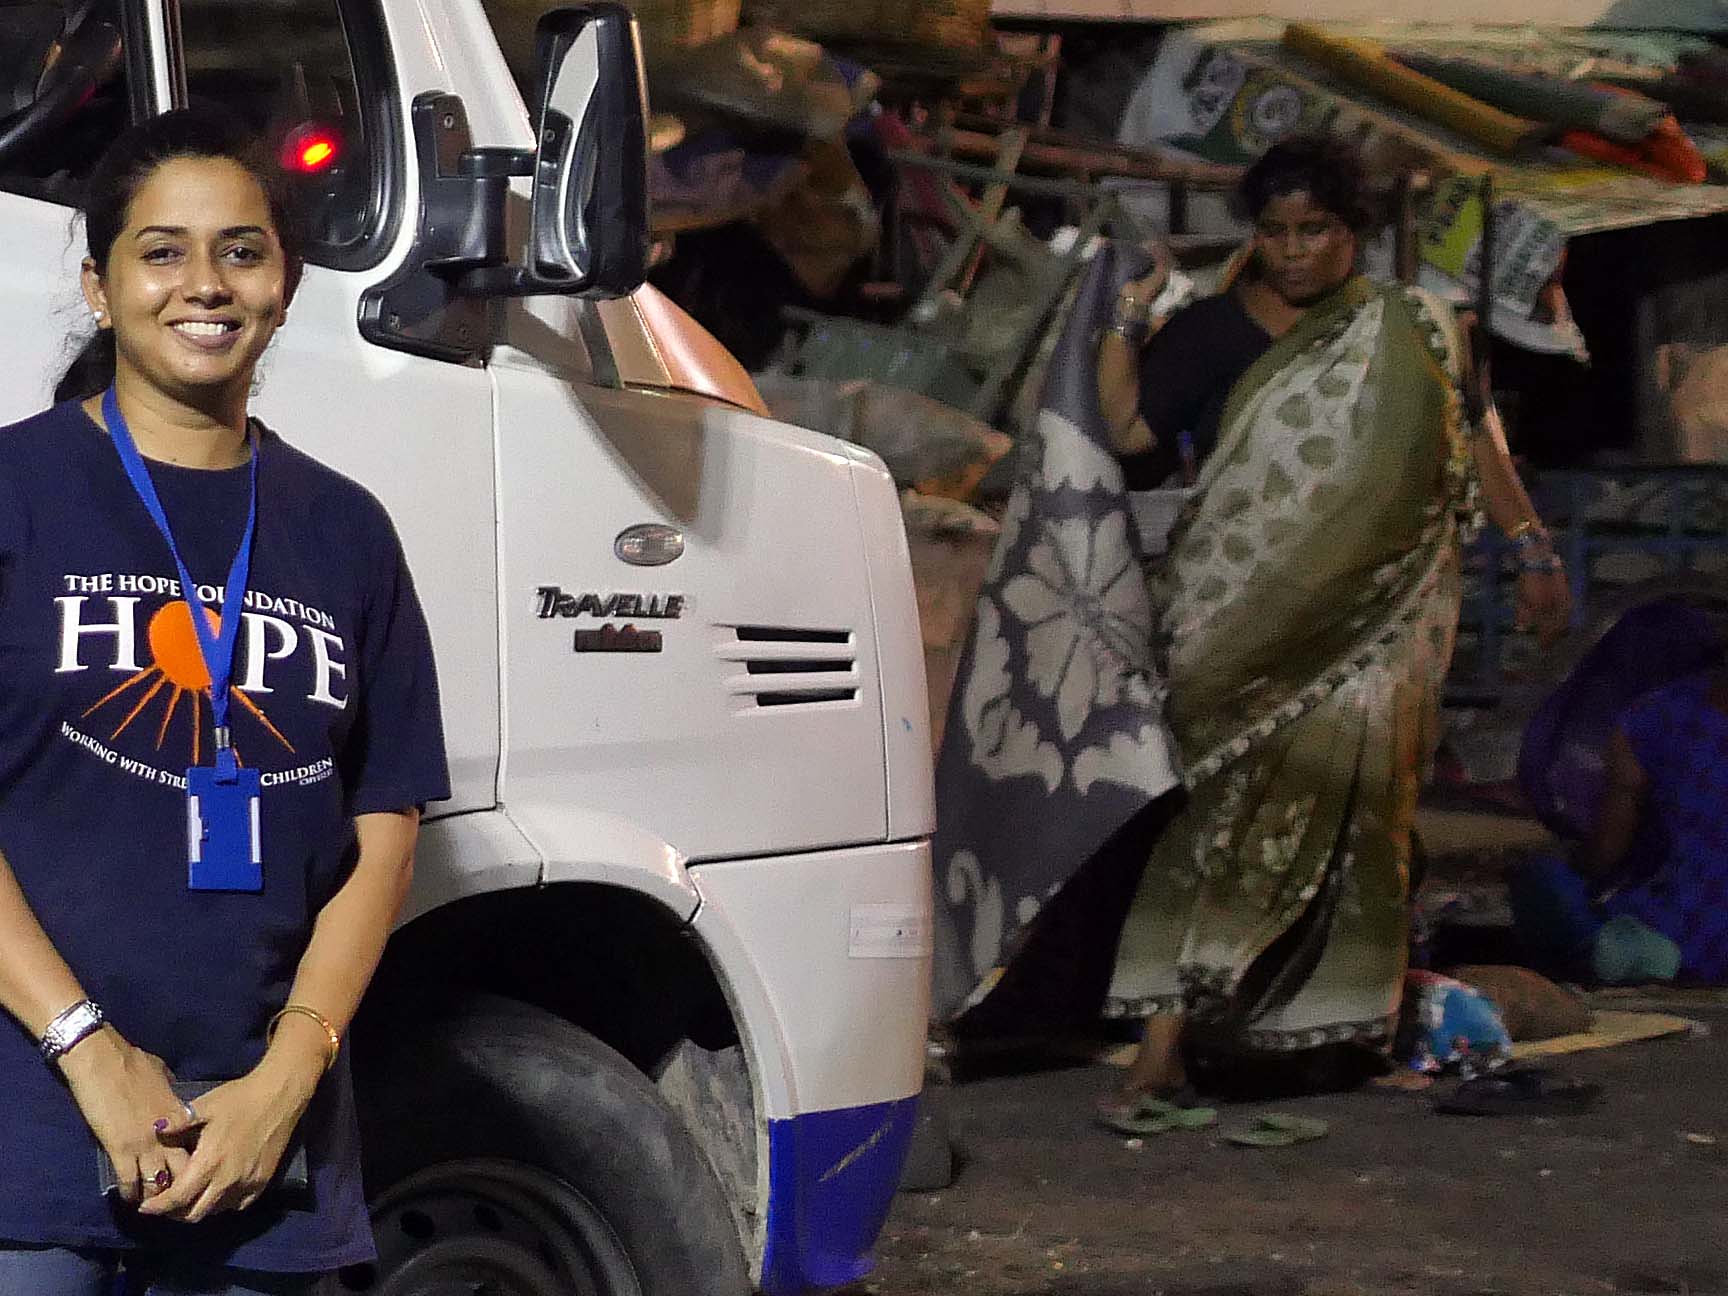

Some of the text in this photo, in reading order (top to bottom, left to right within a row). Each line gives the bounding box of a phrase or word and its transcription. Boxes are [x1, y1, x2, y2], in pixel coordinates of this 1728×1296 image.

[63, 572, 336, 631] THE HOPE ONDATION
[60, 720, 118, 766] WORKING
[119, 756, 158, 781] WITH
[259, 756, 335, 788] CHILDREN
